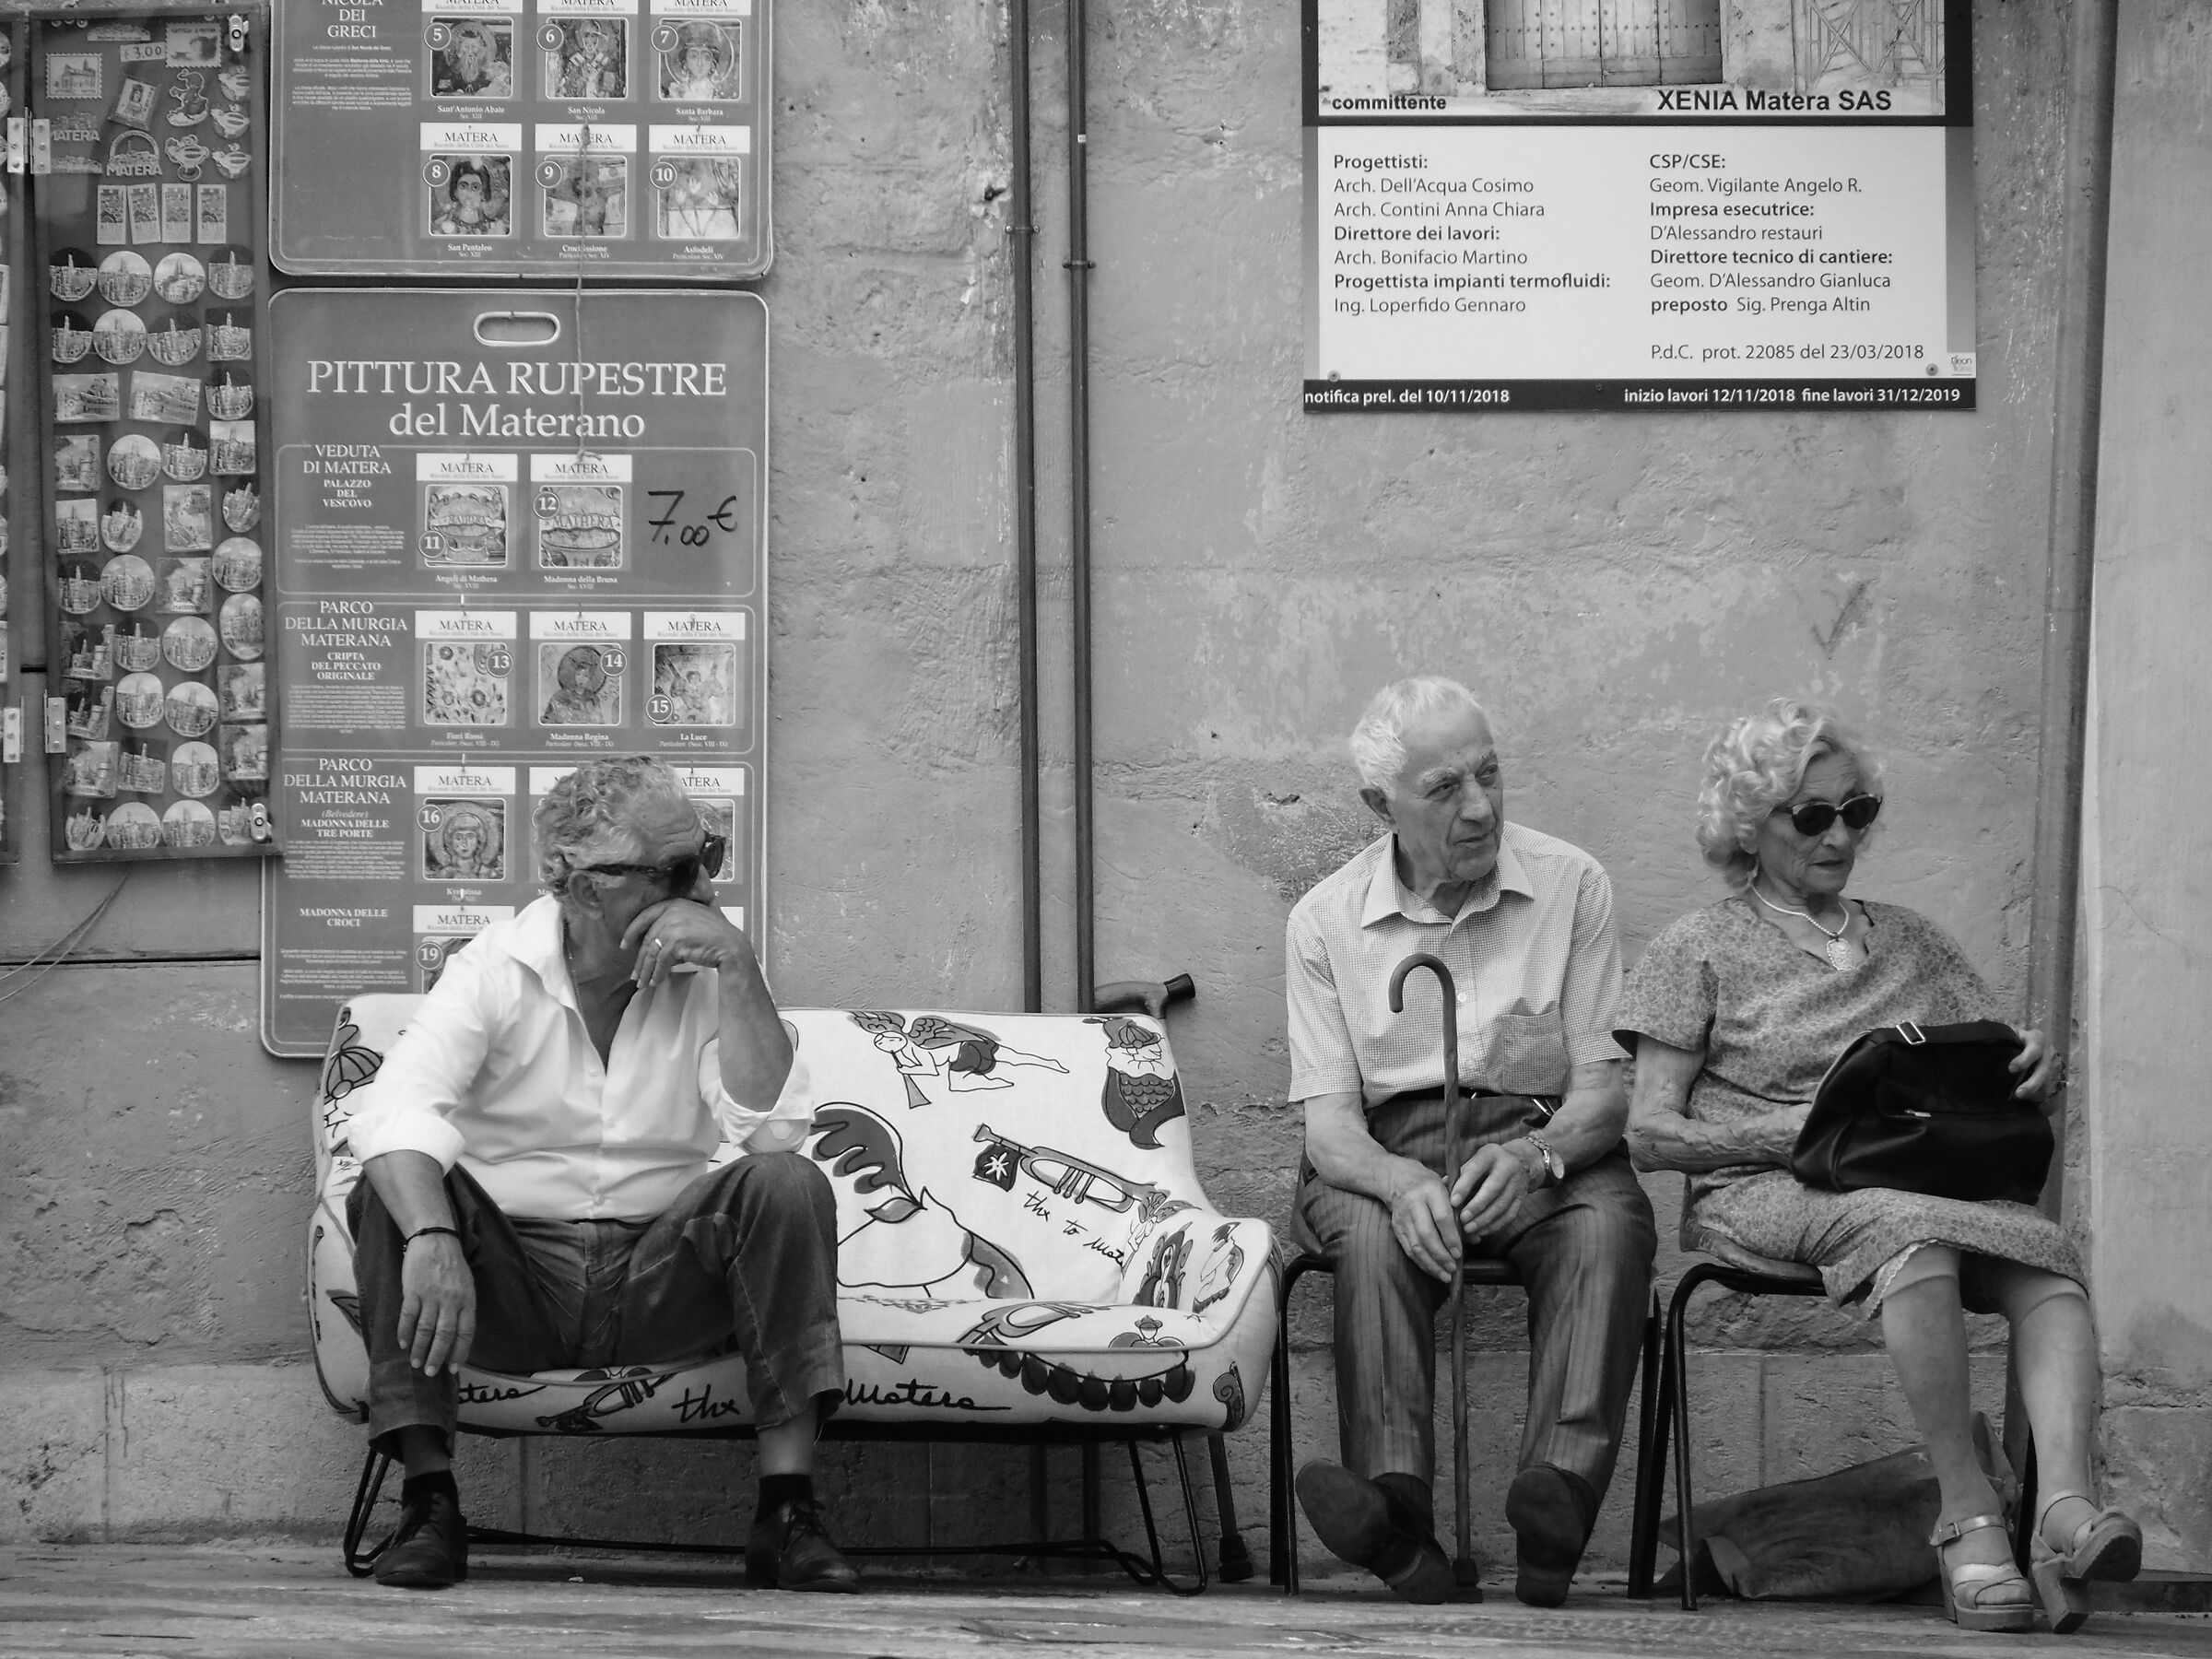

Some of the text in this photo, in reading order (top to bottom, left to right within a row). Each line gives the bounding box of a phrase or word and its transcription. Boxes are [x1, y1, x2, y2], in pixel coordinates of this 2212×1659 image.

[338, 8, 366, 22] DEI
[326, 25, 377, 39] GRECI
[433, 29, 442, 41] 5
[546, 29, 555, 42] 6
[660, 30, 670, 44] 7
[1332, 95, 1447, 110] committente
[1657, 88, 1892, 111] XENIA Matera SAS
[697, 108, 724, 116] Barbara
[445, 132, 498, 143] MATERA
[559, 133, 613, 144] MAERA
[674, 134, 726, 145] MATERA
[1334, 154, 1428, 173] Progettisti:
[1649, 153, 1726, 170] CSP/CSE:
[106, 164, 162, 176] MATERA
[431, 164, 441, 179] 8
[544, 166, 554, 180] 9
[654, 168, 674, 182] 10
[1334, 177, 1535, 196] Arch. Dell'Acqua Cosimo
[1649, 177, 1863, 197] Geom. Vigilante Angelo R.
[1334, 201, 1545, 218] Arch. Contini Anna Chiara
[1650, 201, 1815, 220] Impresa esecutrice:
[1334, 225, 1500, 241] Direttore dei lavori:
[1651, 224, 1823, 241] D'Alessandro restauri
[462, 243, 493, 252] Pantaleo
[684, 245, 713, 255] Asfodeli
[1334, 248, 1528, 265] Arch. Bonifacio Martino
[1651, 248, 1893, 265] Direttore tecnico di cantiere:
[1335, 272, 1610, 293] Progettista impianti termofluidi:
[1650, 272, 1891, 288] Geom. D'Alessandro Gianluca
[1335, 296, 1526, 317] Ing. Loperfido Gennaro
[1651, 296, 1870, 316] preposto Sig. Prenga Altin
[1652, 343, 1924, 363] P.d.C. prot. 22085 del 23/03/2018
[308, 359, 726, 395] PITTURA RUPESTRE
[1304, 388, 1510, 406] notifica prel. del 10/11/2018
[1624, 387, 1960, 403] inizio lavori 12/11/2018 fine lavori 31/12/2019
[390, 401, 644, 437] del Materano
[314, 444, 381, 458] VEDUTA
[303, 460, 392, 475] DI MATERA
[441, 462, 494, 473] MATERA
[555, 463, 608, 474] MATERA
[324, 479, 371, 488] PALAZZO
[336, 488, 358, 498] DEL
[323, 499, 372, 508] VESCOVO
[537, 498, 557, 511] 12
[553, 515, 615, 528] MATHERA
[423, 535, 441, 550] 11
[320, 600, 373, 614] PARCO
[285, 617, 408, 631] DELLA MURGIA
[440, 619, 493, 631] MATERA
[554, 620, 607, 631] MATERA
[668, 619, 722, 632] MATERA
[301, 633, 392, 647] MATERANA
[327, 652, 365, 661] CRIPTA
[490, 655, 510, 669] 13
[605, 654, 623, 667] 14
[333, 662, 382, 671] PECCATO
[316, 671, 375, 681] ORIGINALE
[651, 700, 669, 713] 15
[584, 733, 609, 743] Regina
[690, 733, 708, 741] Luce
[319, 758, 372, 771] PARCO
[284, 774, 407, 788] DELLA MURGIA
[439, 775, 492, 786] MATERA
[681, 776, 721, 787] ATERA
[300, 791, 391, 805] MATERANA
[322, 809, 369, 818] (Belvedere)
[421, 810, 440, 824] 16
[301, 819, 389, 829] MADONNA DELLE
[318, 829, 373, 838] TRE PORTE
[300, 908, 388, 918] MADONNA DELLE
[438, 914, 490, 925] MATERA
[326, 918, 360, 927] CROCI
[419, 947, 439, 961] 19
[672, 1383, 741, 1423] thx
